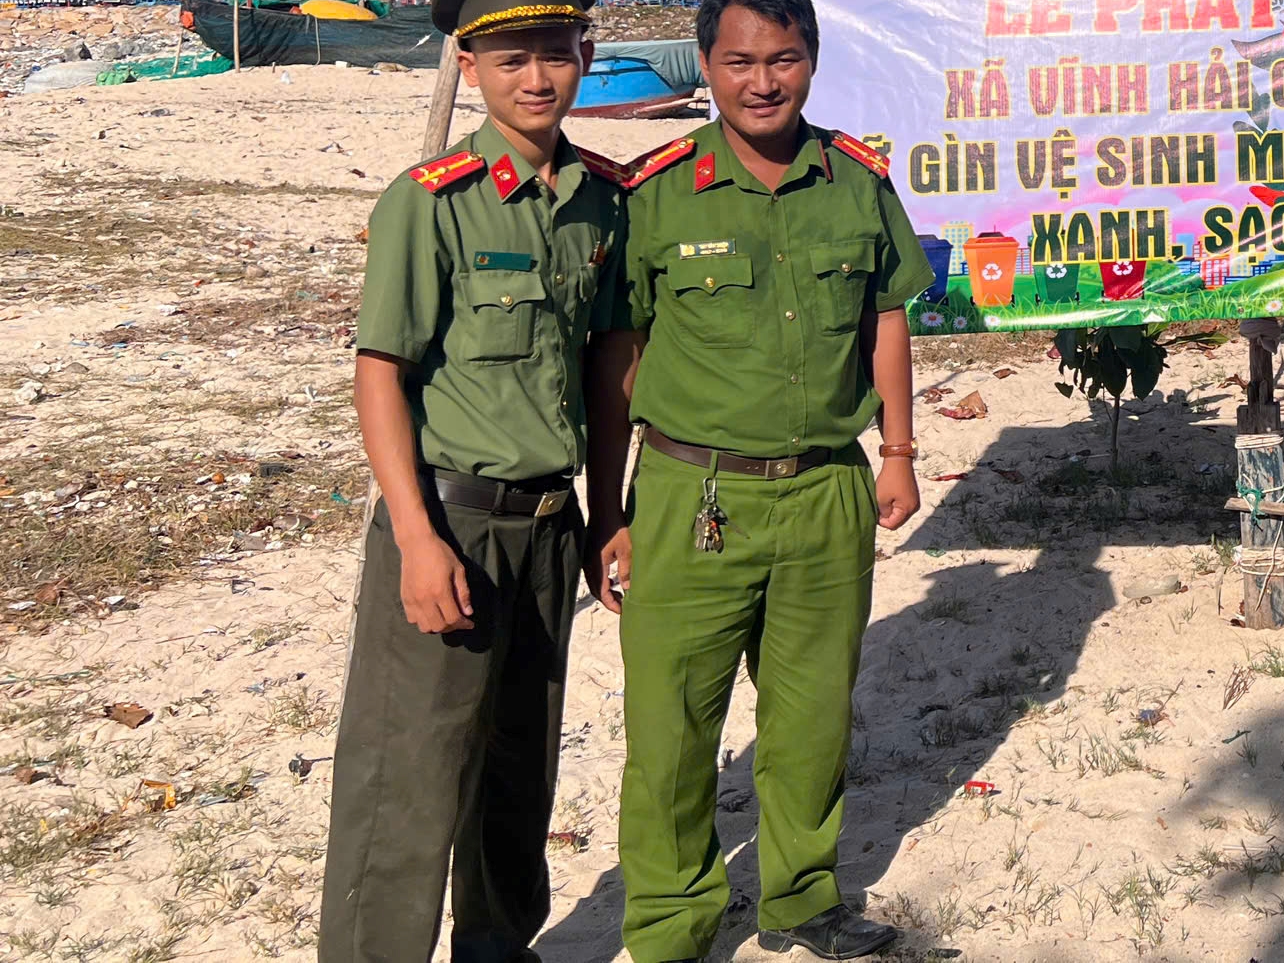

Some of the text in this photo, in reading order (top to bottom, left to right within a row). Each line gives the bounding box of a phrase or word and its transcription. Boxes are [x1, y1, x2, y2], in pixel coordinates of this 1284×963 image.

[944, 56, 1011, 121] XÃ
[1028, 55, 1149, 119] VĨNH
[1168, 45, 1252, 114] HẢI
[908, 131, 998, 195] GÌN
[1015, 126, 1079, 201] VỆ
[1095, 133, 1218, 188] SINH
[1030, 207, 1186, 264] XANH,
